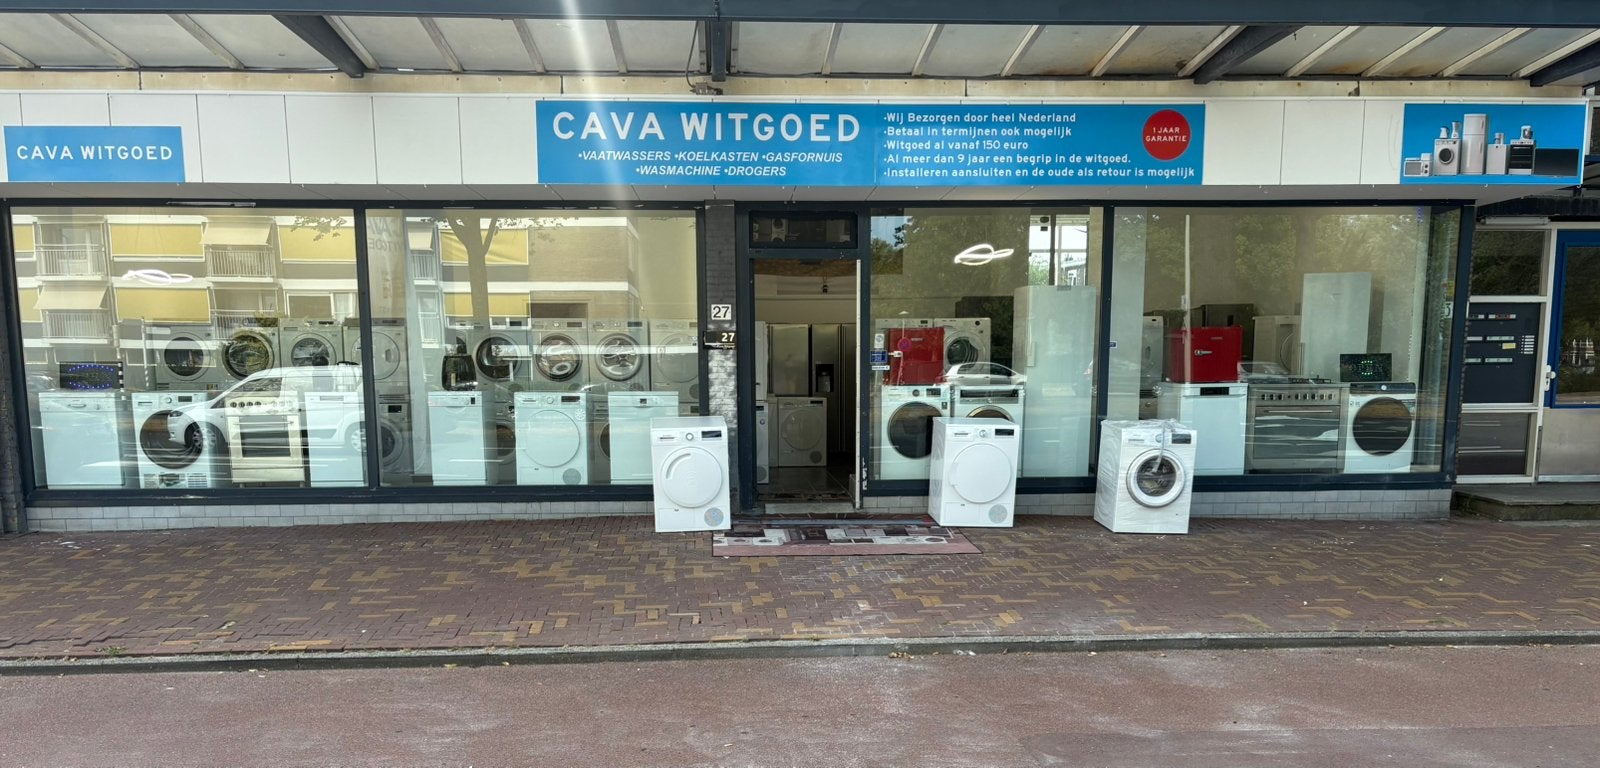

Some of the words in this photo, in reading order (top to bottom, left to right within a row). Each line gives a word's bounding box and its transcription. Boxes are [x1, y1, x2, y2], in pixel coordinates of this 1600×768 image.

[908, 113, 960, 125] Bezorgen
[964, 113, 988, 123] door
[992, 113, 1014, 123] heel
[1019, 113, 1076, 123] Nederland
[553, 112, 665, 141] CAVA
[680, 113, 860, 142] WITGOED
[928, 127, 938, 136] in
[941, 127, 998, 138] termijnen
[1001, 127, 1020, 136] ook
[1024, 127, 1072, 138] mogelijk
[934, 140, 944, 150] al
[948, 140, 979, 150] vanaf
[983, 140, 1000, 150] 150
[1004, 142, 1028, 150] euro
[17, 145, 73, 160] CAVA
[80, 145, 173, 161] WITGOED
[903, 156, 930, 164] meer
[934, 154, 954, 164] dan
[958, 154, 965, 164] 9
[967, 154, 990, 166] jaar
[993, 156, 1013, 164] een
[1017, 154, 1052, 166] begrip
[1055, 154, 1065, 164] in
[1069, 154, 1082, 164] de
[1086, 154, 1131, 166] witgoed.
[952, 167, 1012, 177] aansluiten
[1015, 169, 1028, 177] en
[1032, 167, 1044, 177] de
[1048, 167, 1074, 177] oude
[1078, 167, 1093, 177] als
[1097, 168, 1131, 177] retour
[1134, 168, 1144, 177] is
[1148, 168, 1195, 179] mogelijk
[713, 306, 730, 318] 27
[721, 332, 735, 342] 27
